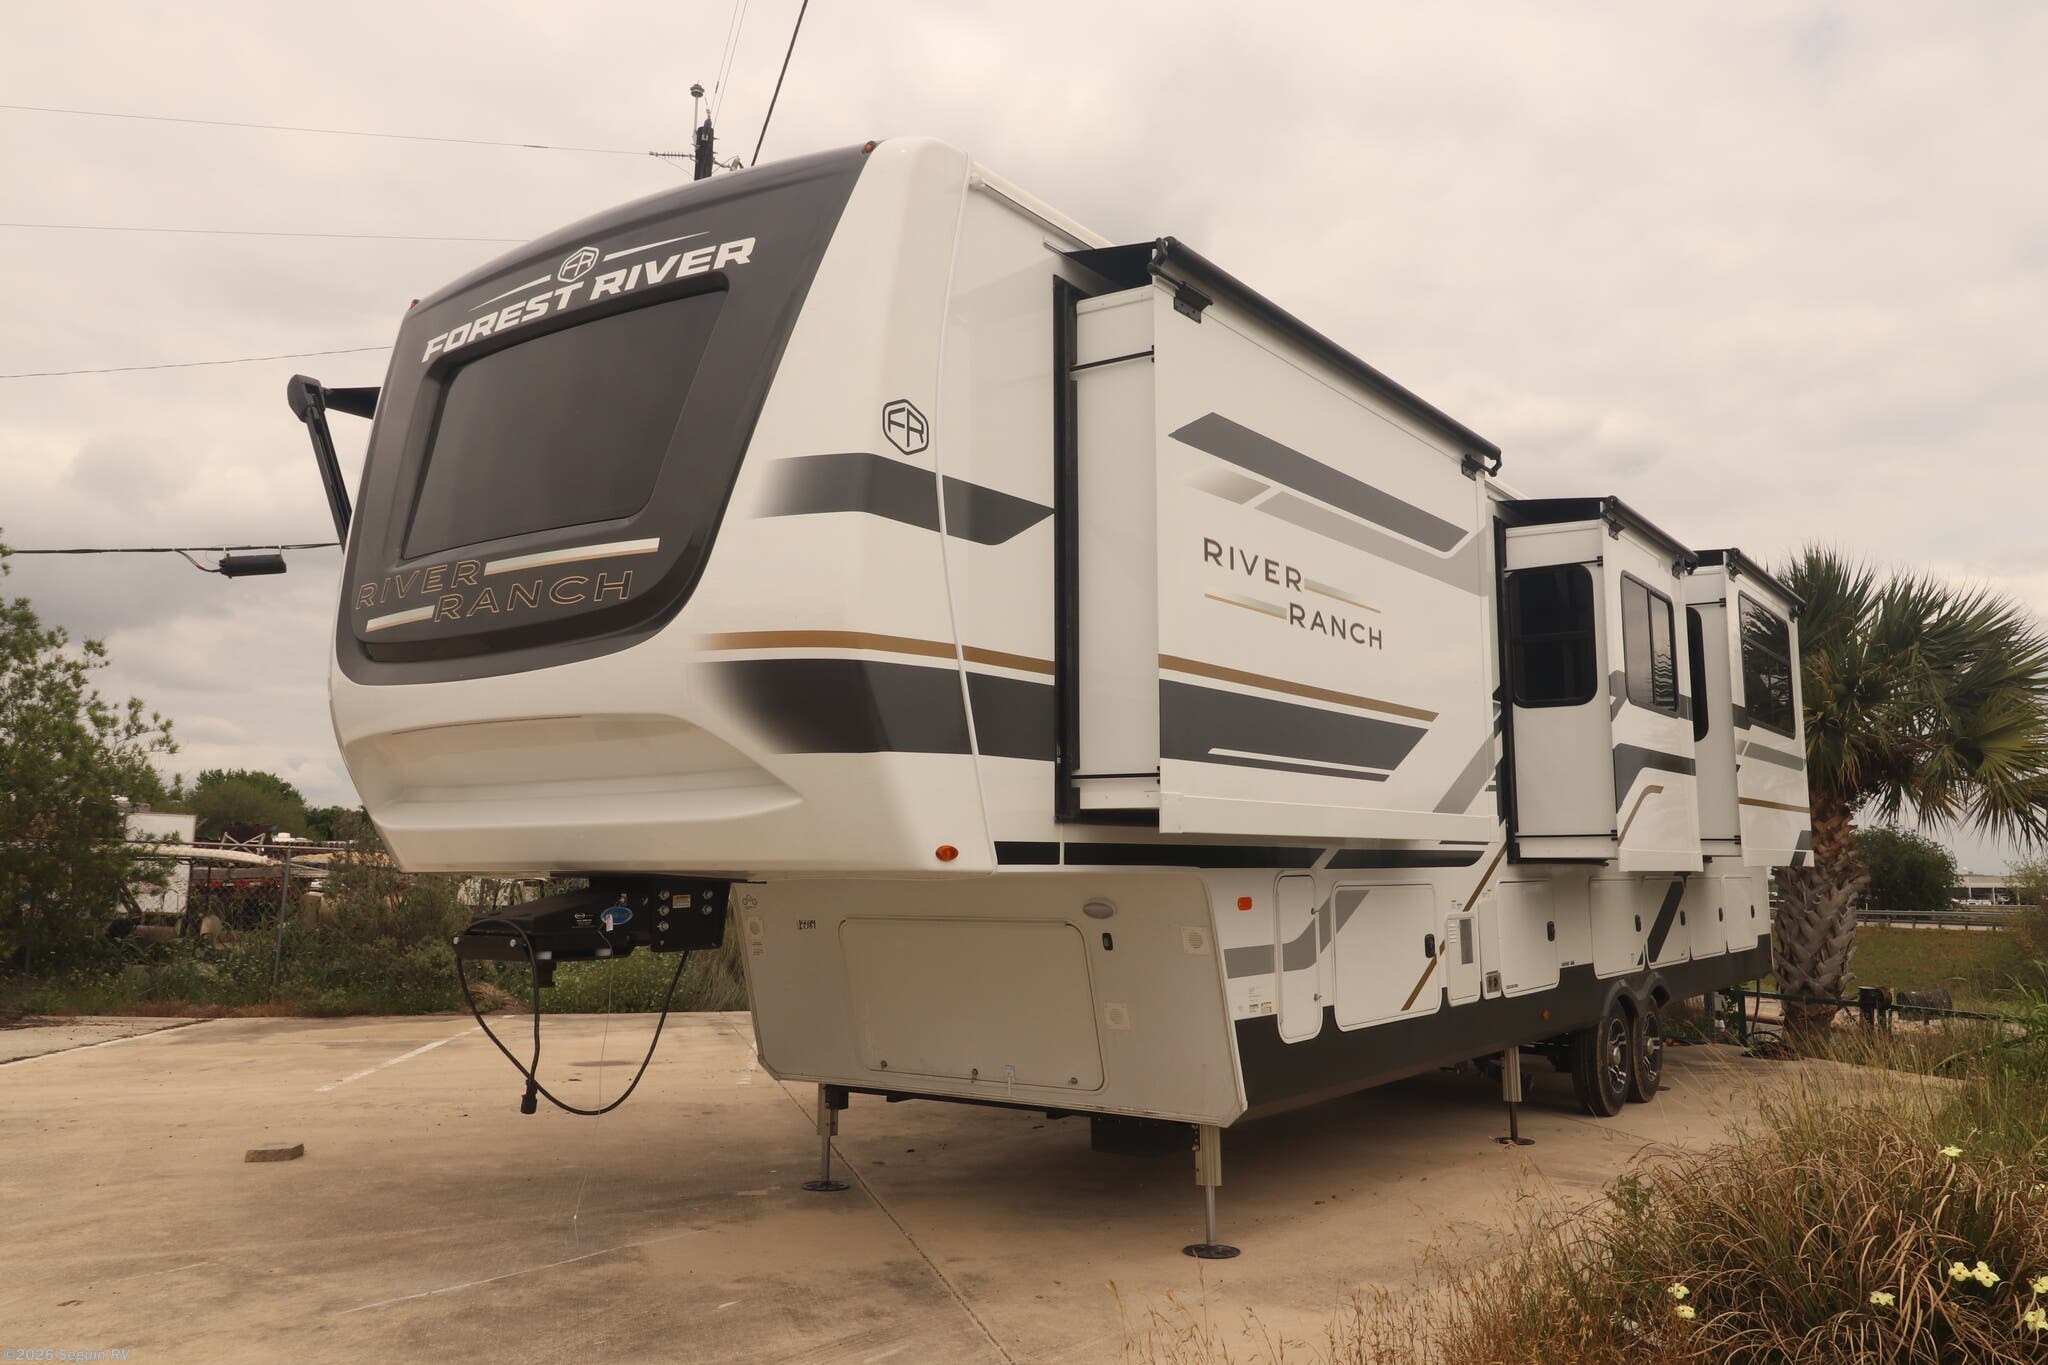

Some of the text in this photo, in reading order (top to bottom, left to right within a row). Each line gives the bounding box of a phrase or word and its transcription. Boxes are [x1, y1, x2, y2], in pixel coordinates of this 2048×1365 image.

[422, 237, 756, 363] FOREST RIVER
[355, 559, 481, 610] RIVER
[1203, 537, 1302, 593] RIVER
[434, 570, 633, 622] RANCH
[1289, 602, 1383, 650] RANCH
